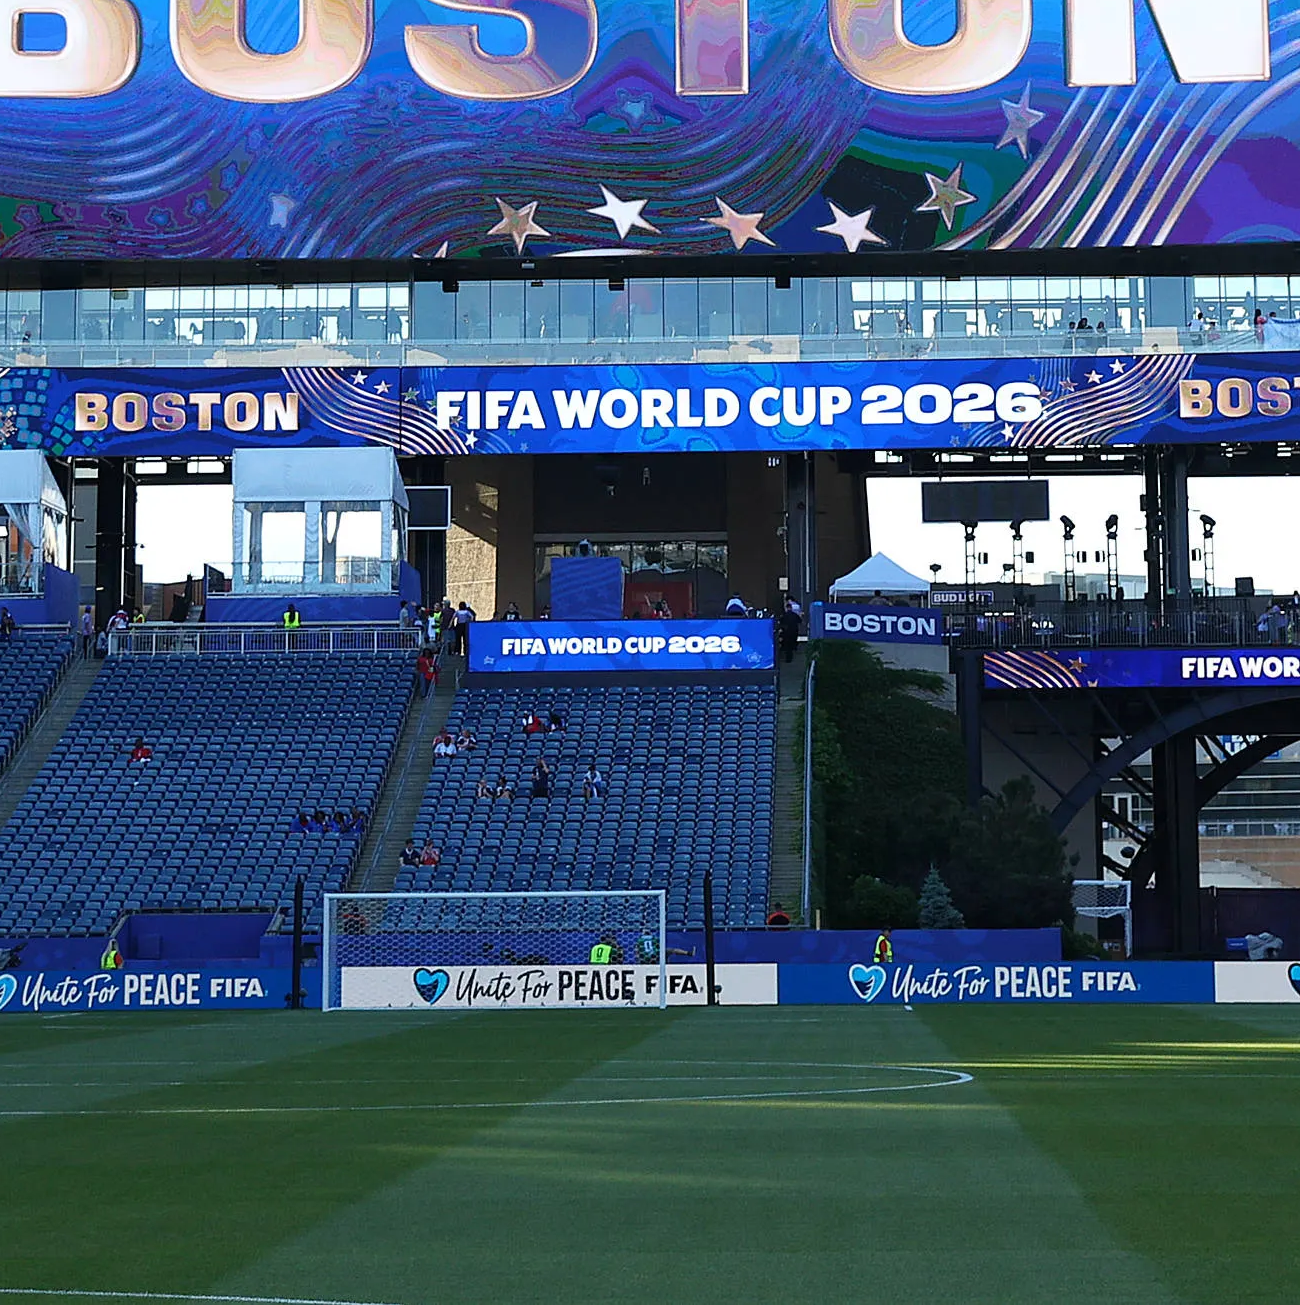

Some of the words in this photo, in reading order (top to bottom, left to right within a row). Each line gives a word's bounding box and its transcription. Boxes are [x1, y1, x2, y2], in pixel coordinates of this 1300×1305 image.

[74, 391, 303, 432] BOSTON
[435, 391, 546, 430] FIFA
[552, 387, 740, 430] WORLD
[748, 385, 852, 427] CUP
[861, 382, 1045, 425] 2026
[824, 612, 936, 636] BOSTON
[502, 638, 547, 655] FIFA
[547, 637, 623, 655] WORLD
[624, 636, 667, 654] CUP
[668, 635, 741, 654] 2026
[1182, 657, 1238, 679] FIFA
[22, 973, 83, 1011] Unite
[83, 973, 120, 1009] For
[123, 973, 201, 1006] PEACE
[210, 978, 264, 998] FIFA
[455, 967, 516, 1006] Unite
[516, 969, 554, 1003] For
[558, 969, 636, 1002] PEACE
[645, 975, 699, 994] FFA
[891, 964, 953, 1003] Unite
[953, 966, 990, 1000] For
[994, 966, 1073, 998] PEACE
[1082, 971, 1137, 992] FIFA
